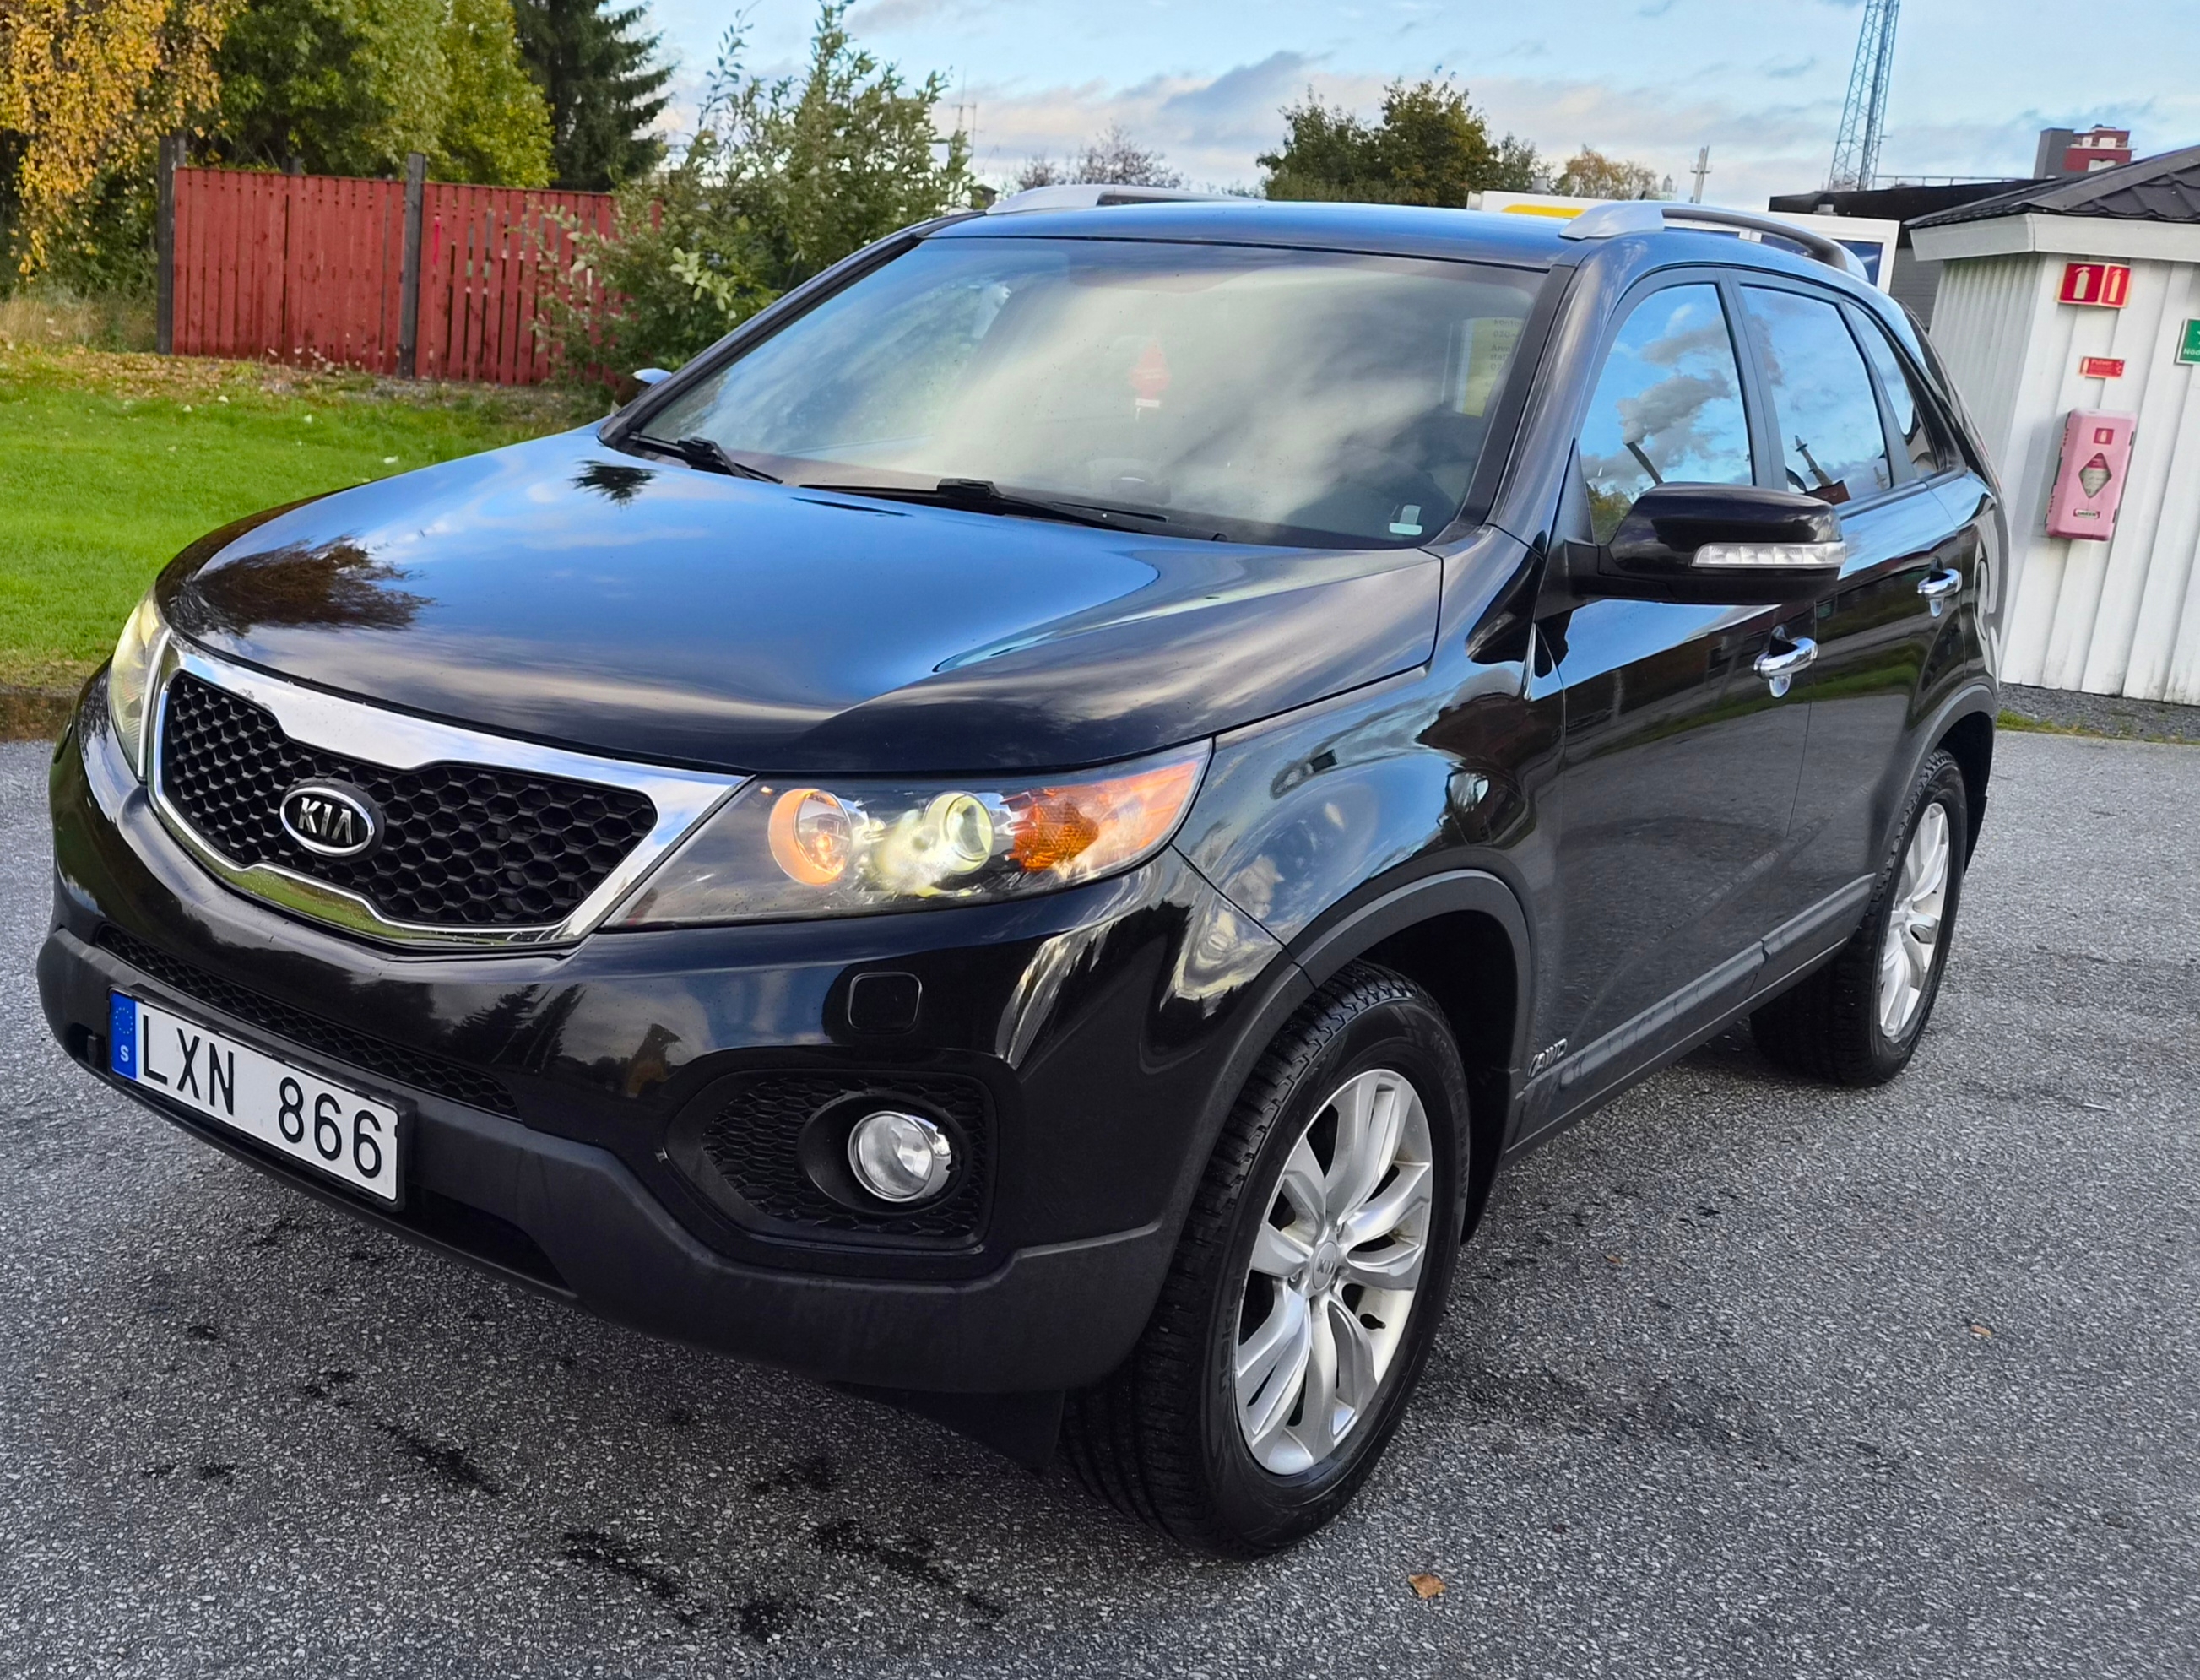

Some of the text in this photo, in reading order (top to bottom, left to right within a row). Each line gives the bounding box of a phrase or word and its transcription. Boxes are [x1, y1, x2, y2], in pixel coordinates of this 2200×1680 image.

[298, 797, 352, 844] KIA
[120, 1044, 129, 1062] S
[143, 1014, 382, 1179] LXN 866
